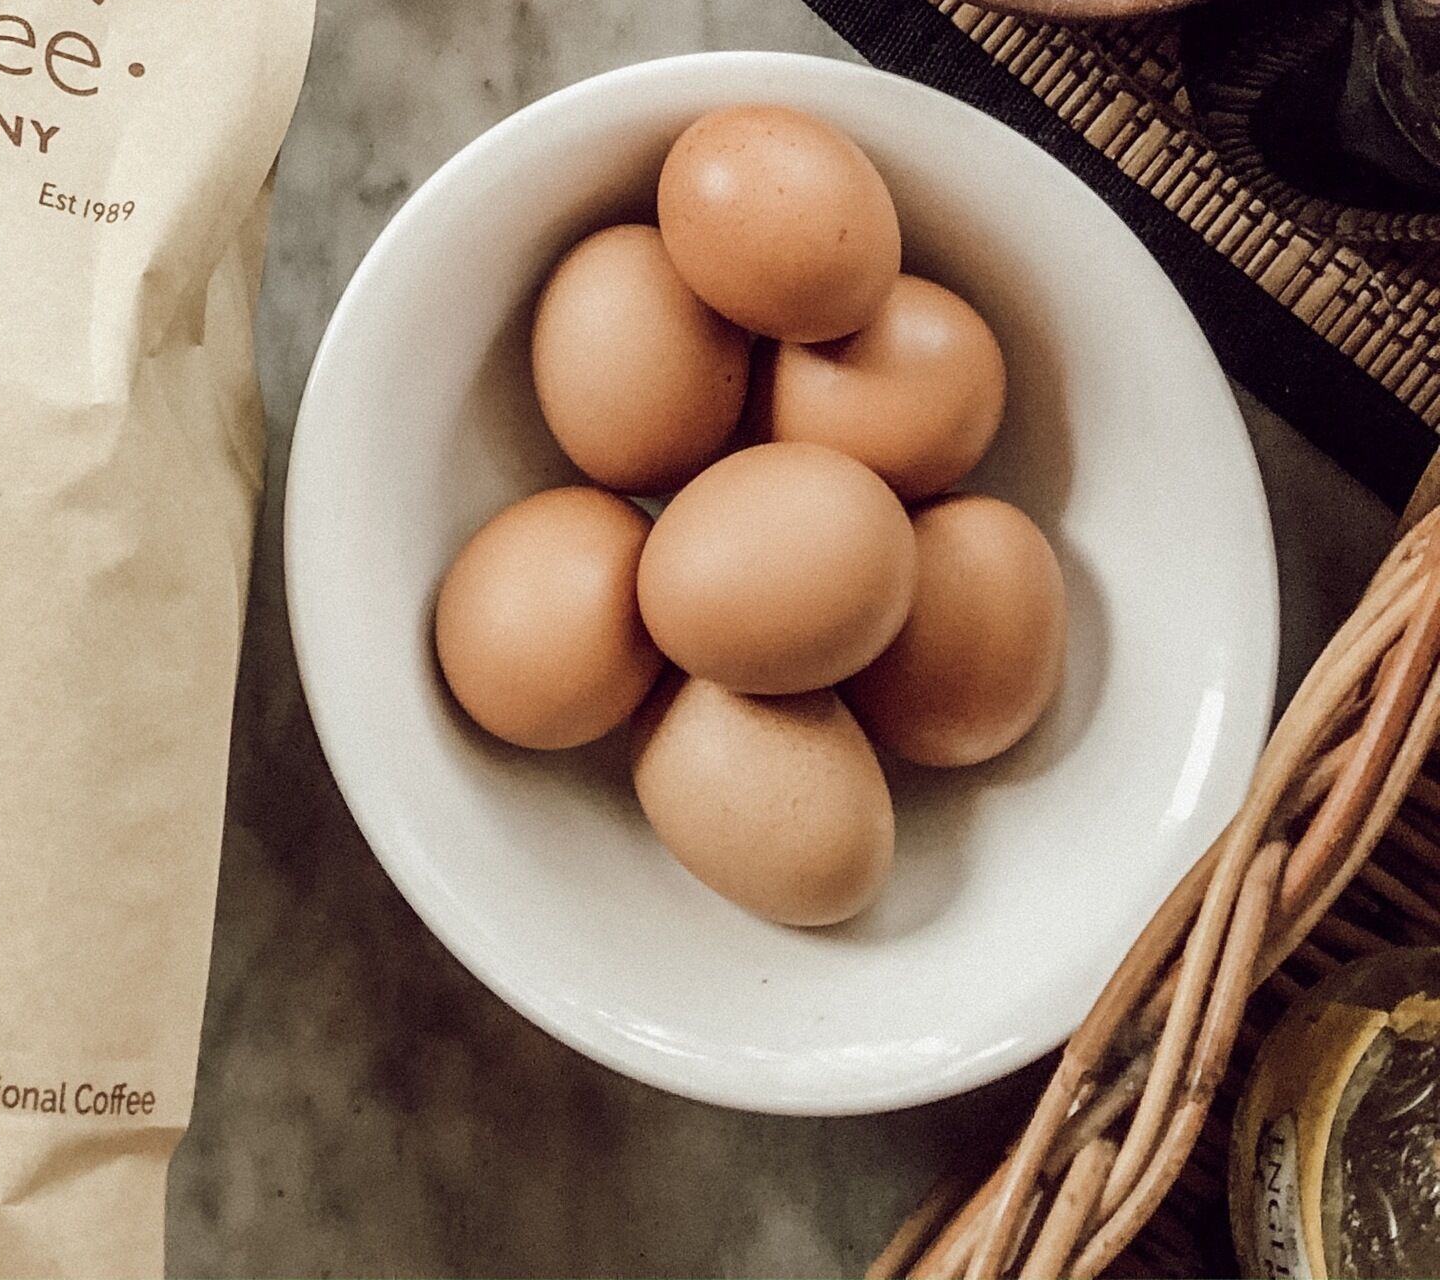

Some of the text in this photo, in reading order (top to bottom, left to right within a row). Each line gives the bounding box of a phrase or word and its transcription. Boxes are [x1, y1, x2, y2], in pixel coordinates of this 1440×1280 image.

[38, 184, 136, 226] Est 1989
[73, 1083, 158, 1118] Coffee
